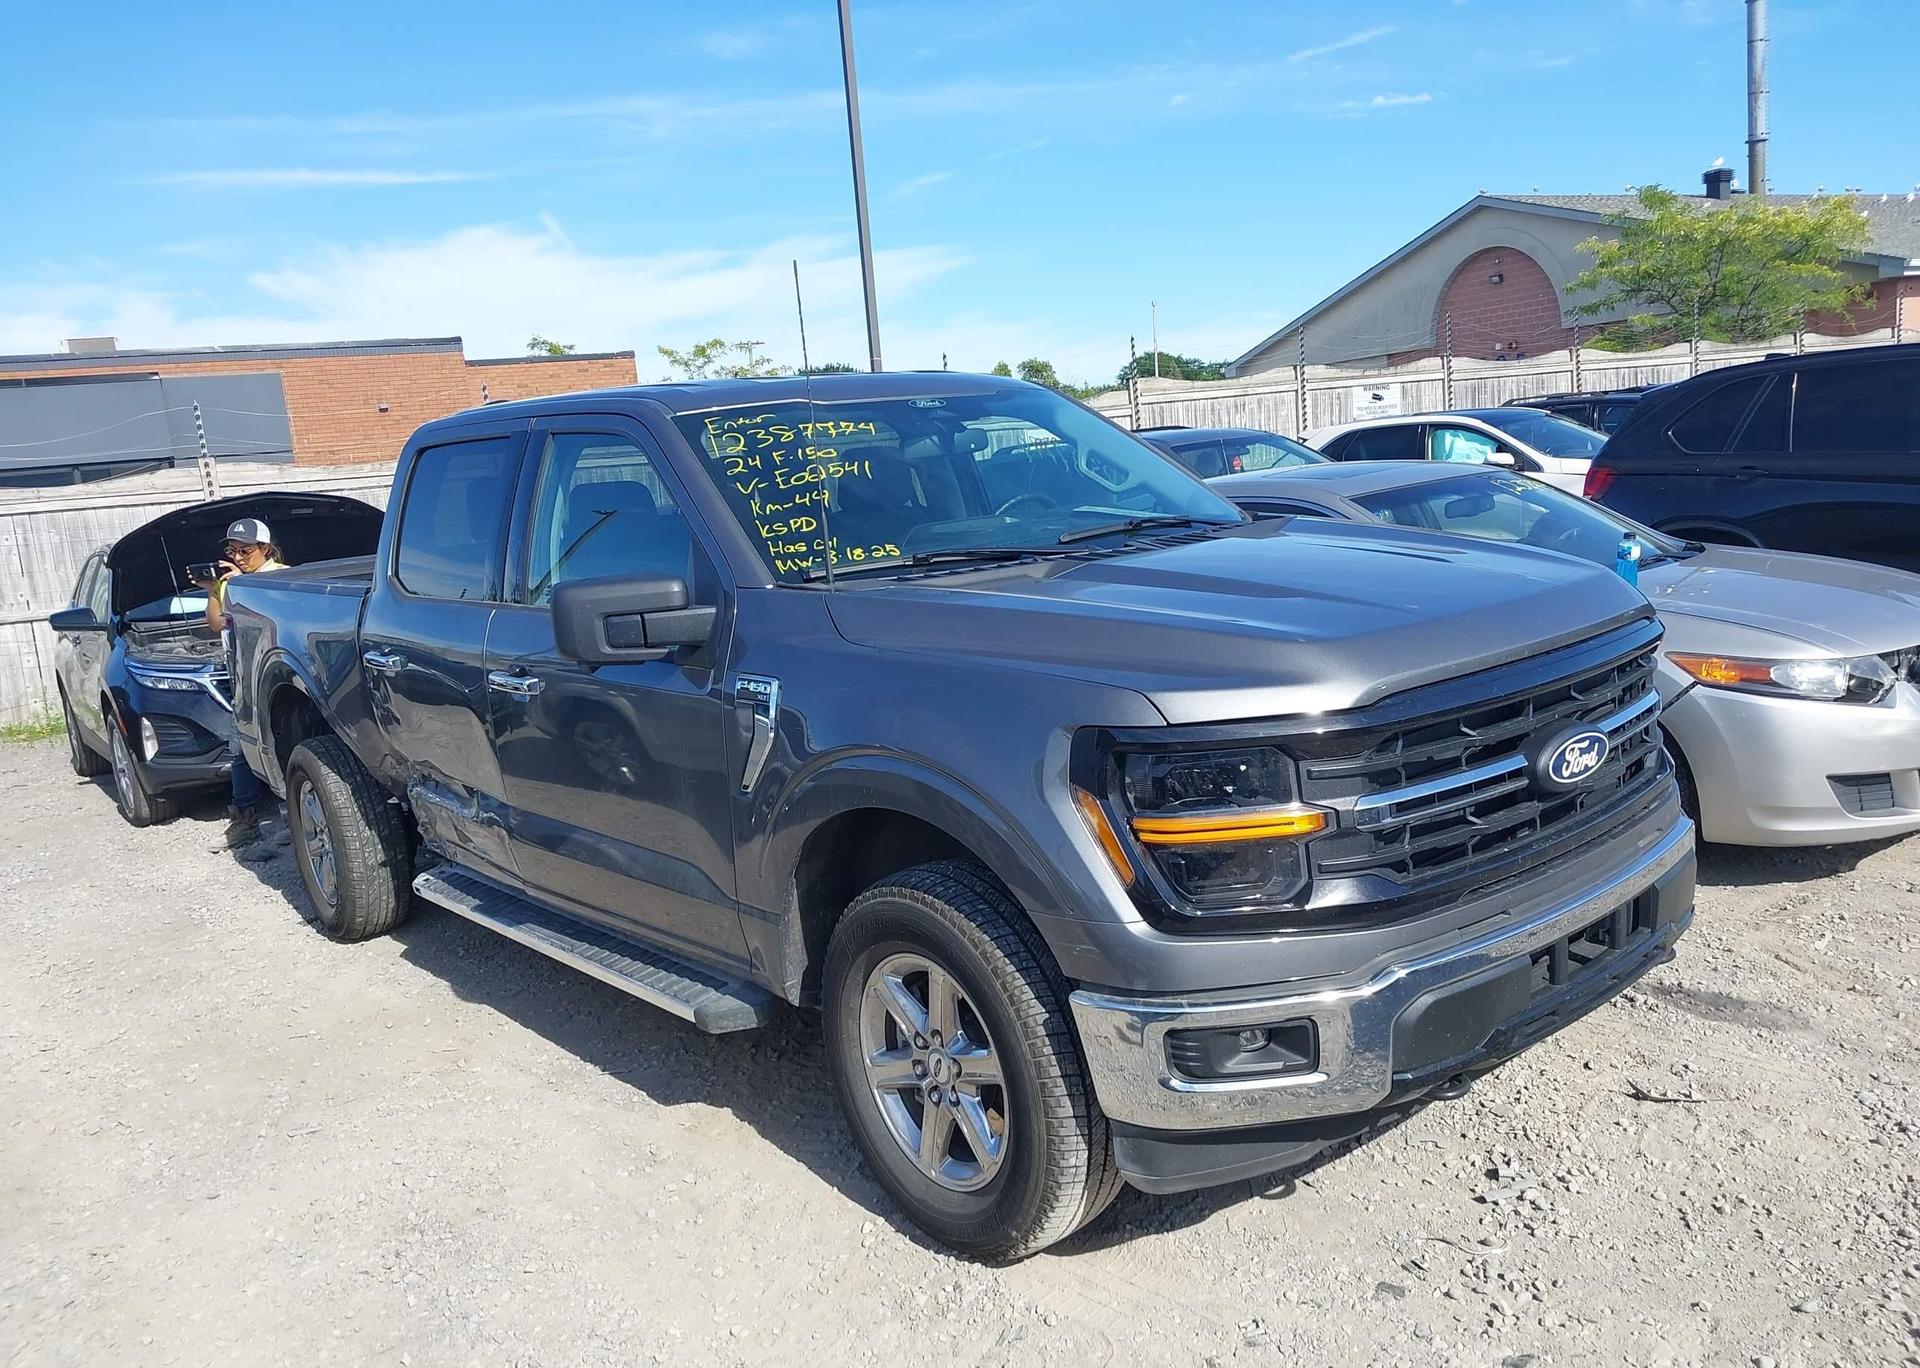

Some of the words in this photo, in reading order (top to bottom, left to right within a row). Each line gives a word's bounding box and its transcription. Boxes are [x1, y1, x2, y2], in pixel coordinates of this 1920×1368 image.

[1363, 384, 1390, 392] WARNING
[723, 455, 763, 476] 24
[1562, 740, 1598, 777] Ford
